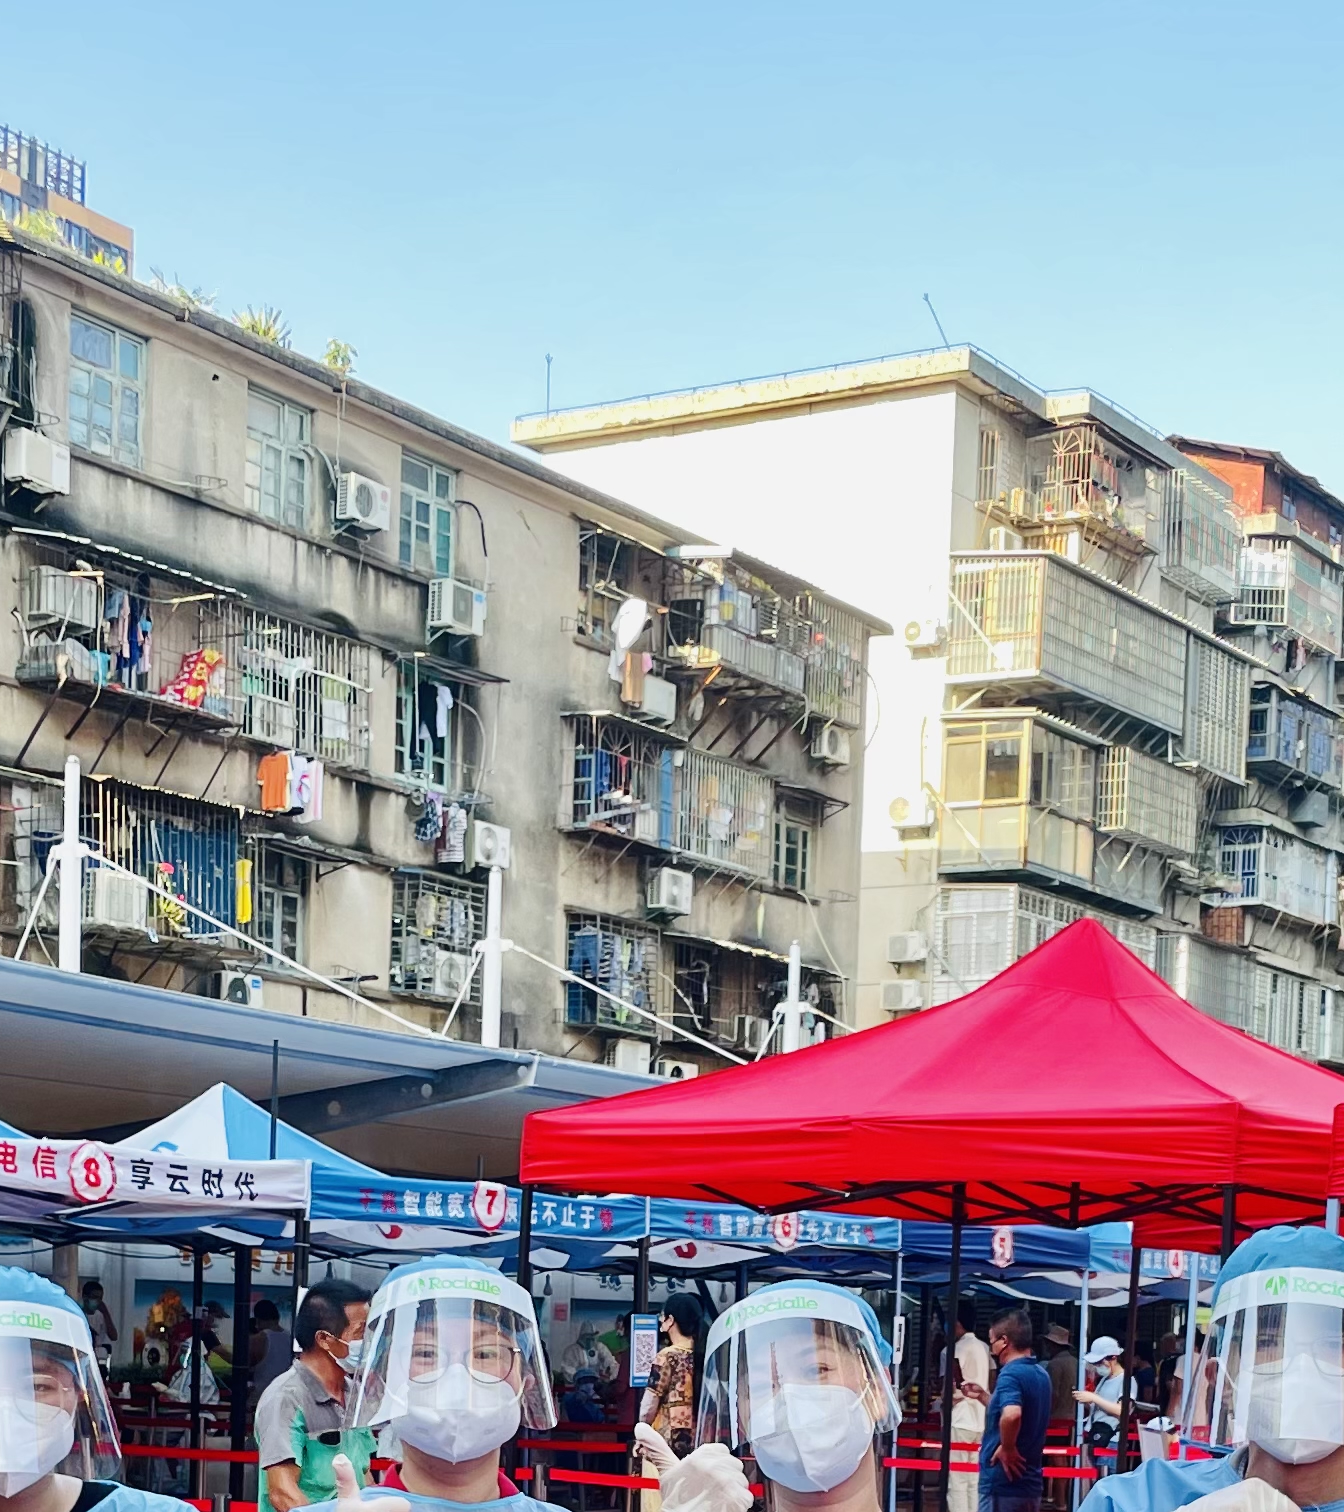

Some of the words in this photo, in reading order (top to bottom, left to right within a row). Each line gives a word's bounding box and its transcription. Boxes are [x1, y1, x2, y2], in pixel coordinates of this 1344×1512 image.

[84, 1158, 102, 1188] 8
[484, 1190, 499, 1216] 7
[781, 1215, 791, 1236] 6
[1172, 1252, 1179, 1267] 4
[428, 1276, 501, 1295] Rocialle
[743, 1296, 818, 1319] Rocialle
